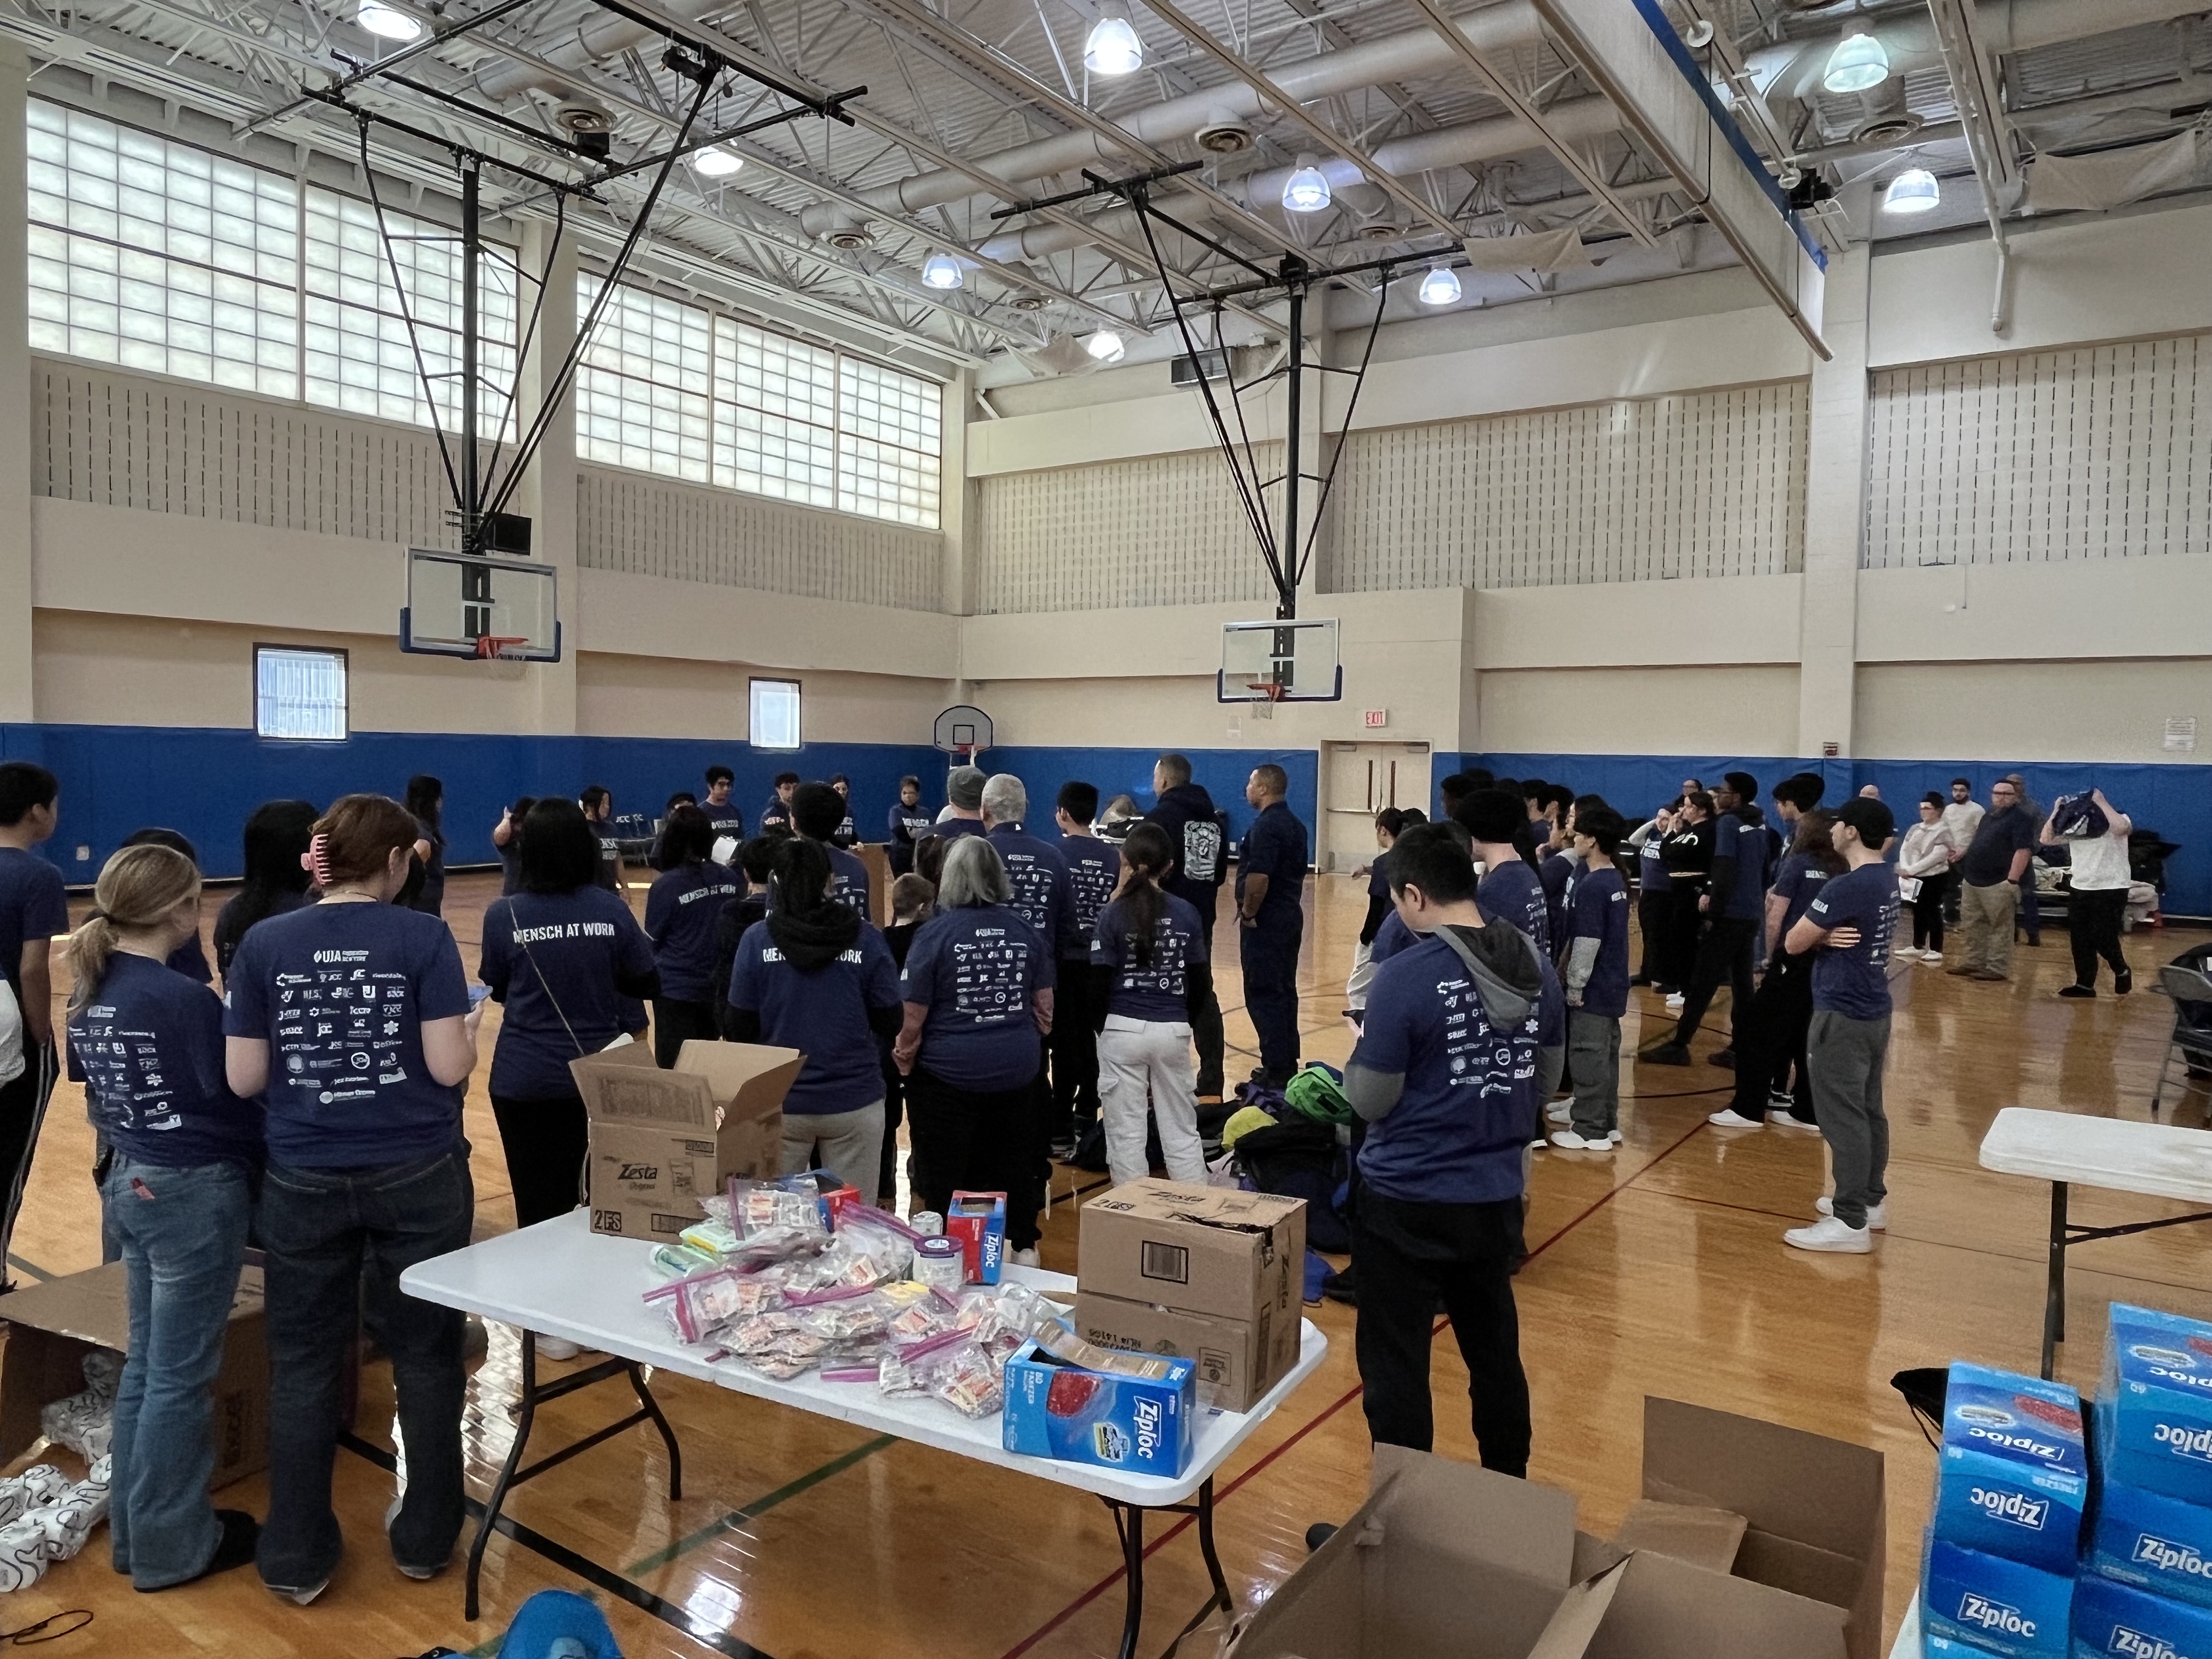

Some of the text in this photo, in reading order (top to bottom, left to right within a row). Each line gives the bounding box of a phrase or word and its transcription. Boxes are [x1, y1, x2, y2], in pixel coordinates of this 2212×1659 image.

[513, 922, 615, 944] MENSCH AT WORK
[763, 947, 786, 962] MEN
[617, 1163, 658, 1180] Zesta
[984, 1235, 999, 1268] Ziploc
[1133, 1402, 1158, 1459] Ziploc
[1969, 1427, 2056, 1458] Ziploc
[1970, 1487, 2041, 1526] Ziploc
[2140, 1538, 2212, 1578] Ziploc
[1966, 1598, 2036, 1638] Ziploc
[2116, 1629, 2190, 1659] Ziplo
